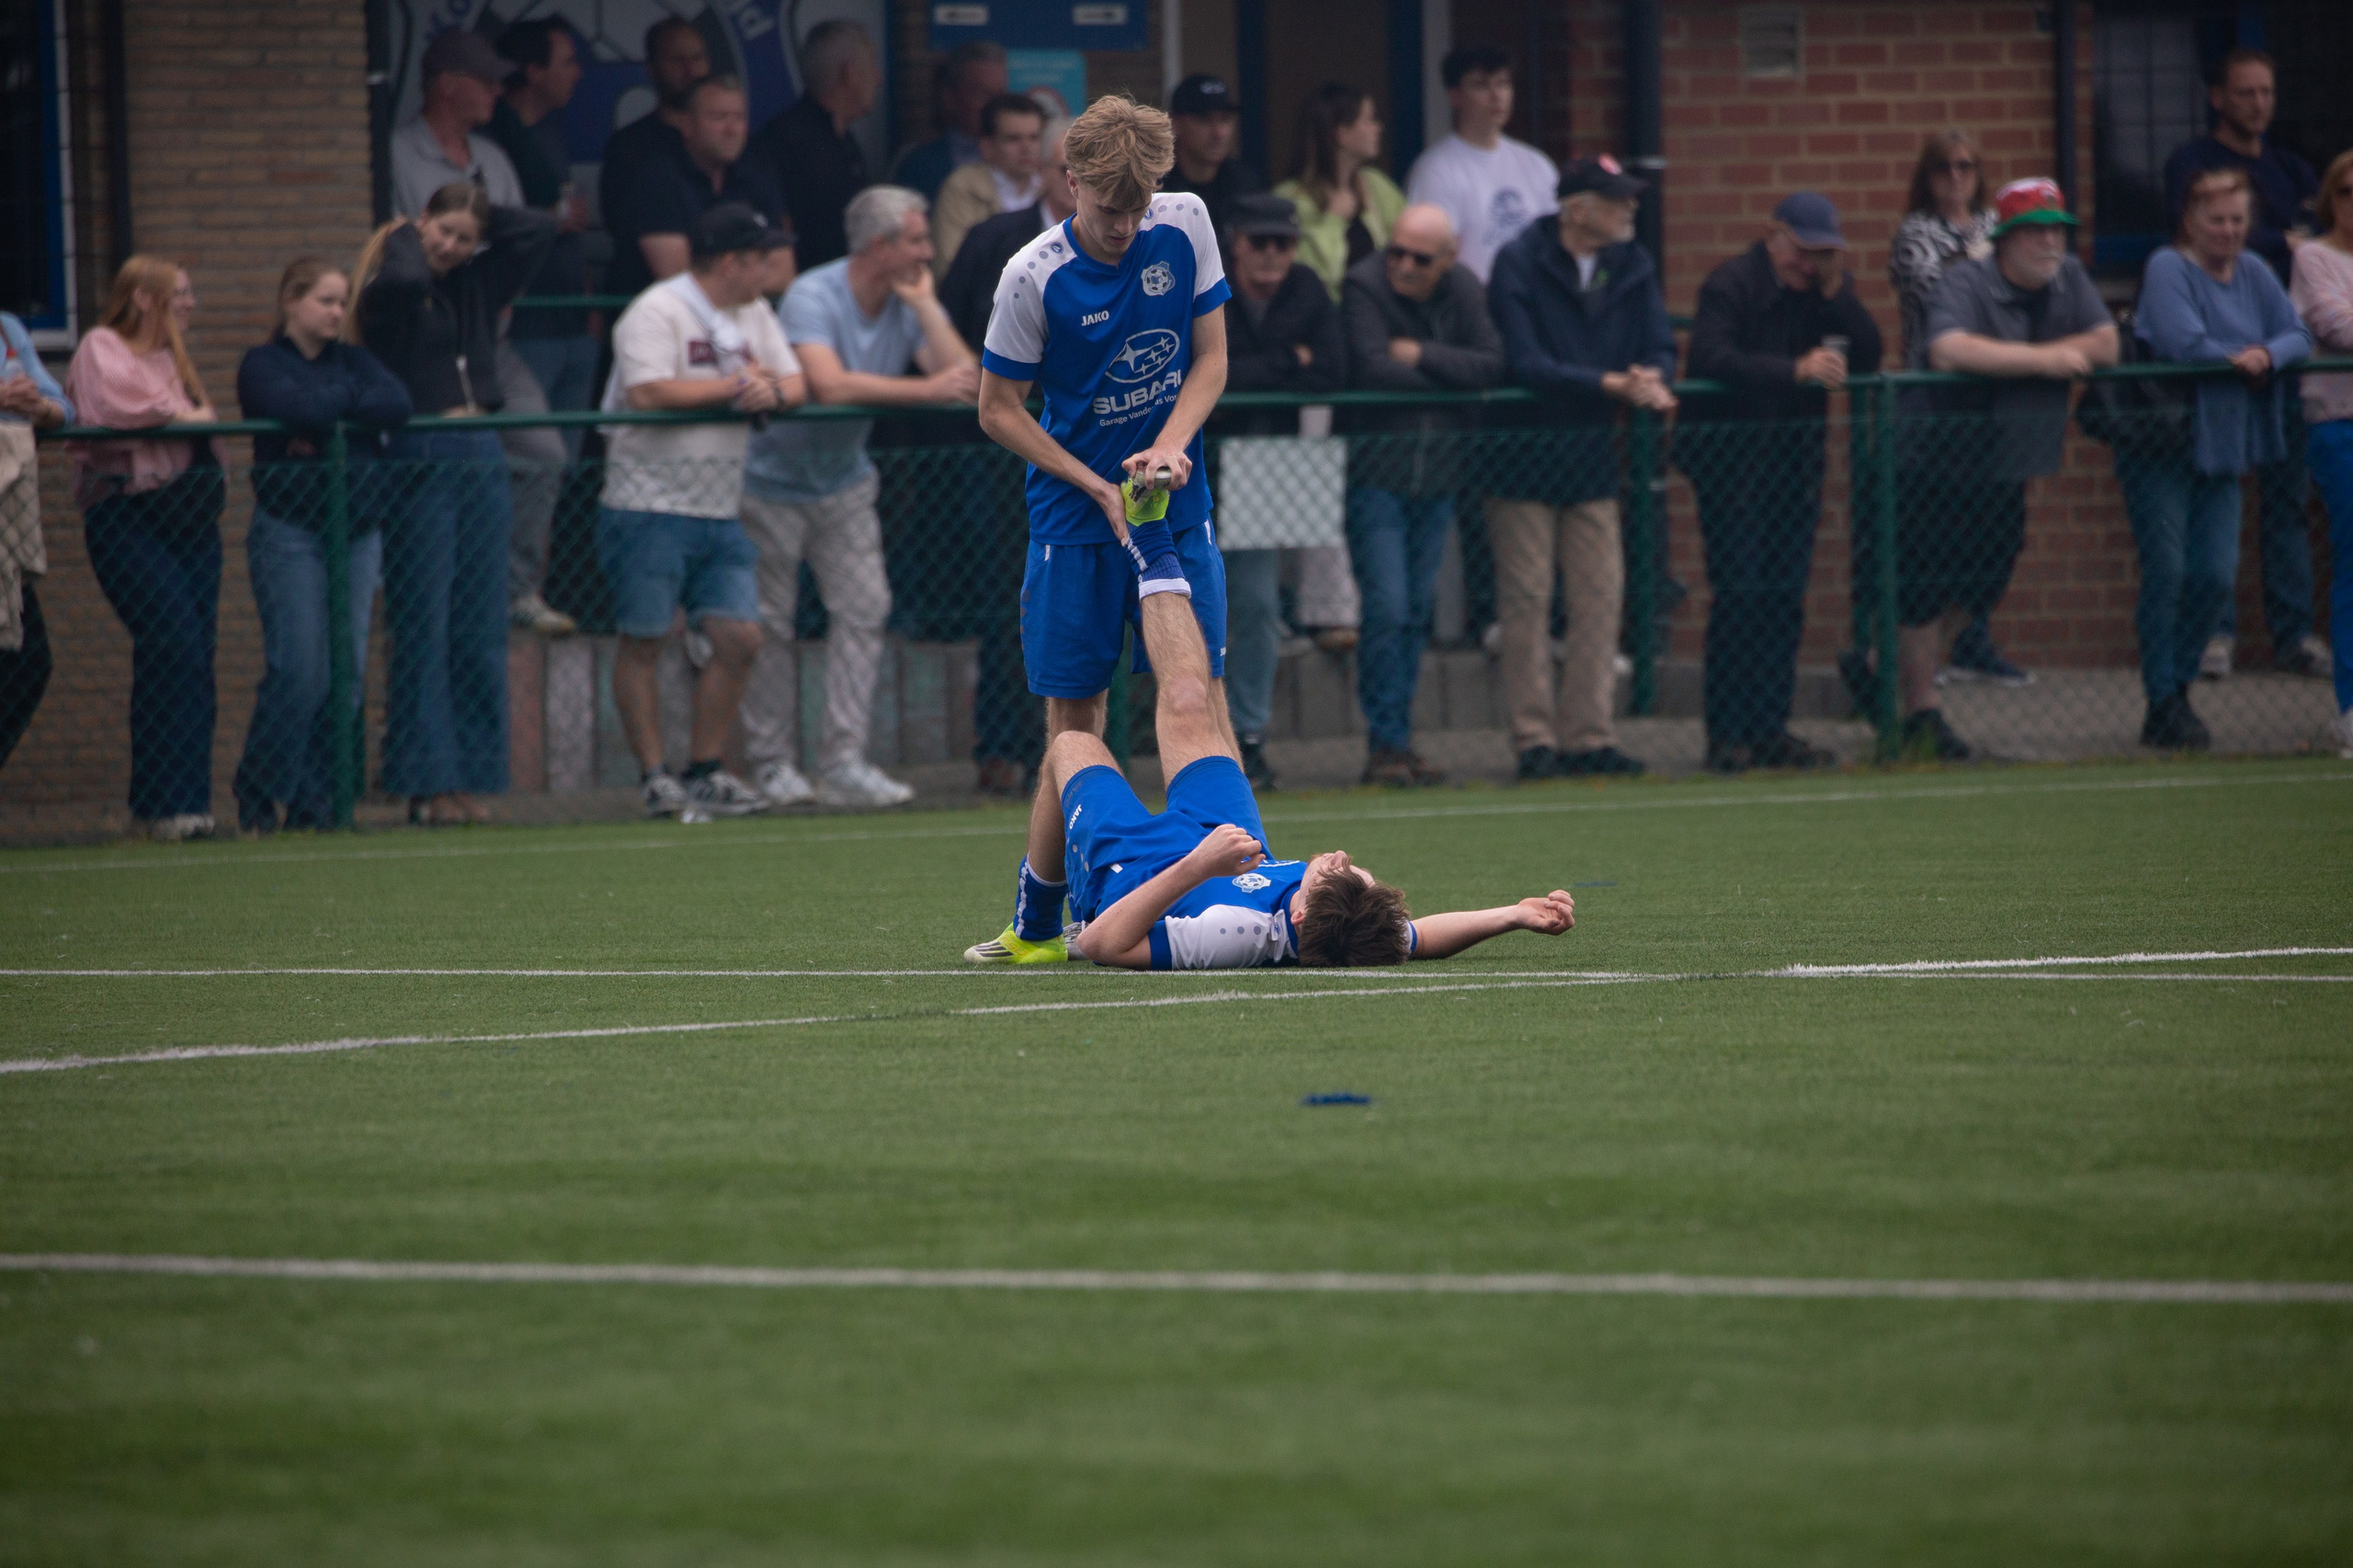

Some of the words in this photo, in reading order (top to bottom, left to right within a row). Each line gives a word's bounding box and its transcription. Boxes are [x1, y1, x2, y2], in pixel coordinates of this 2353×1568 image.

[1081, 310, 1109, 326] JAKO
[1099, 415, 1128, 426] Garage
[1069, 803, 1083, 830] JAKO
